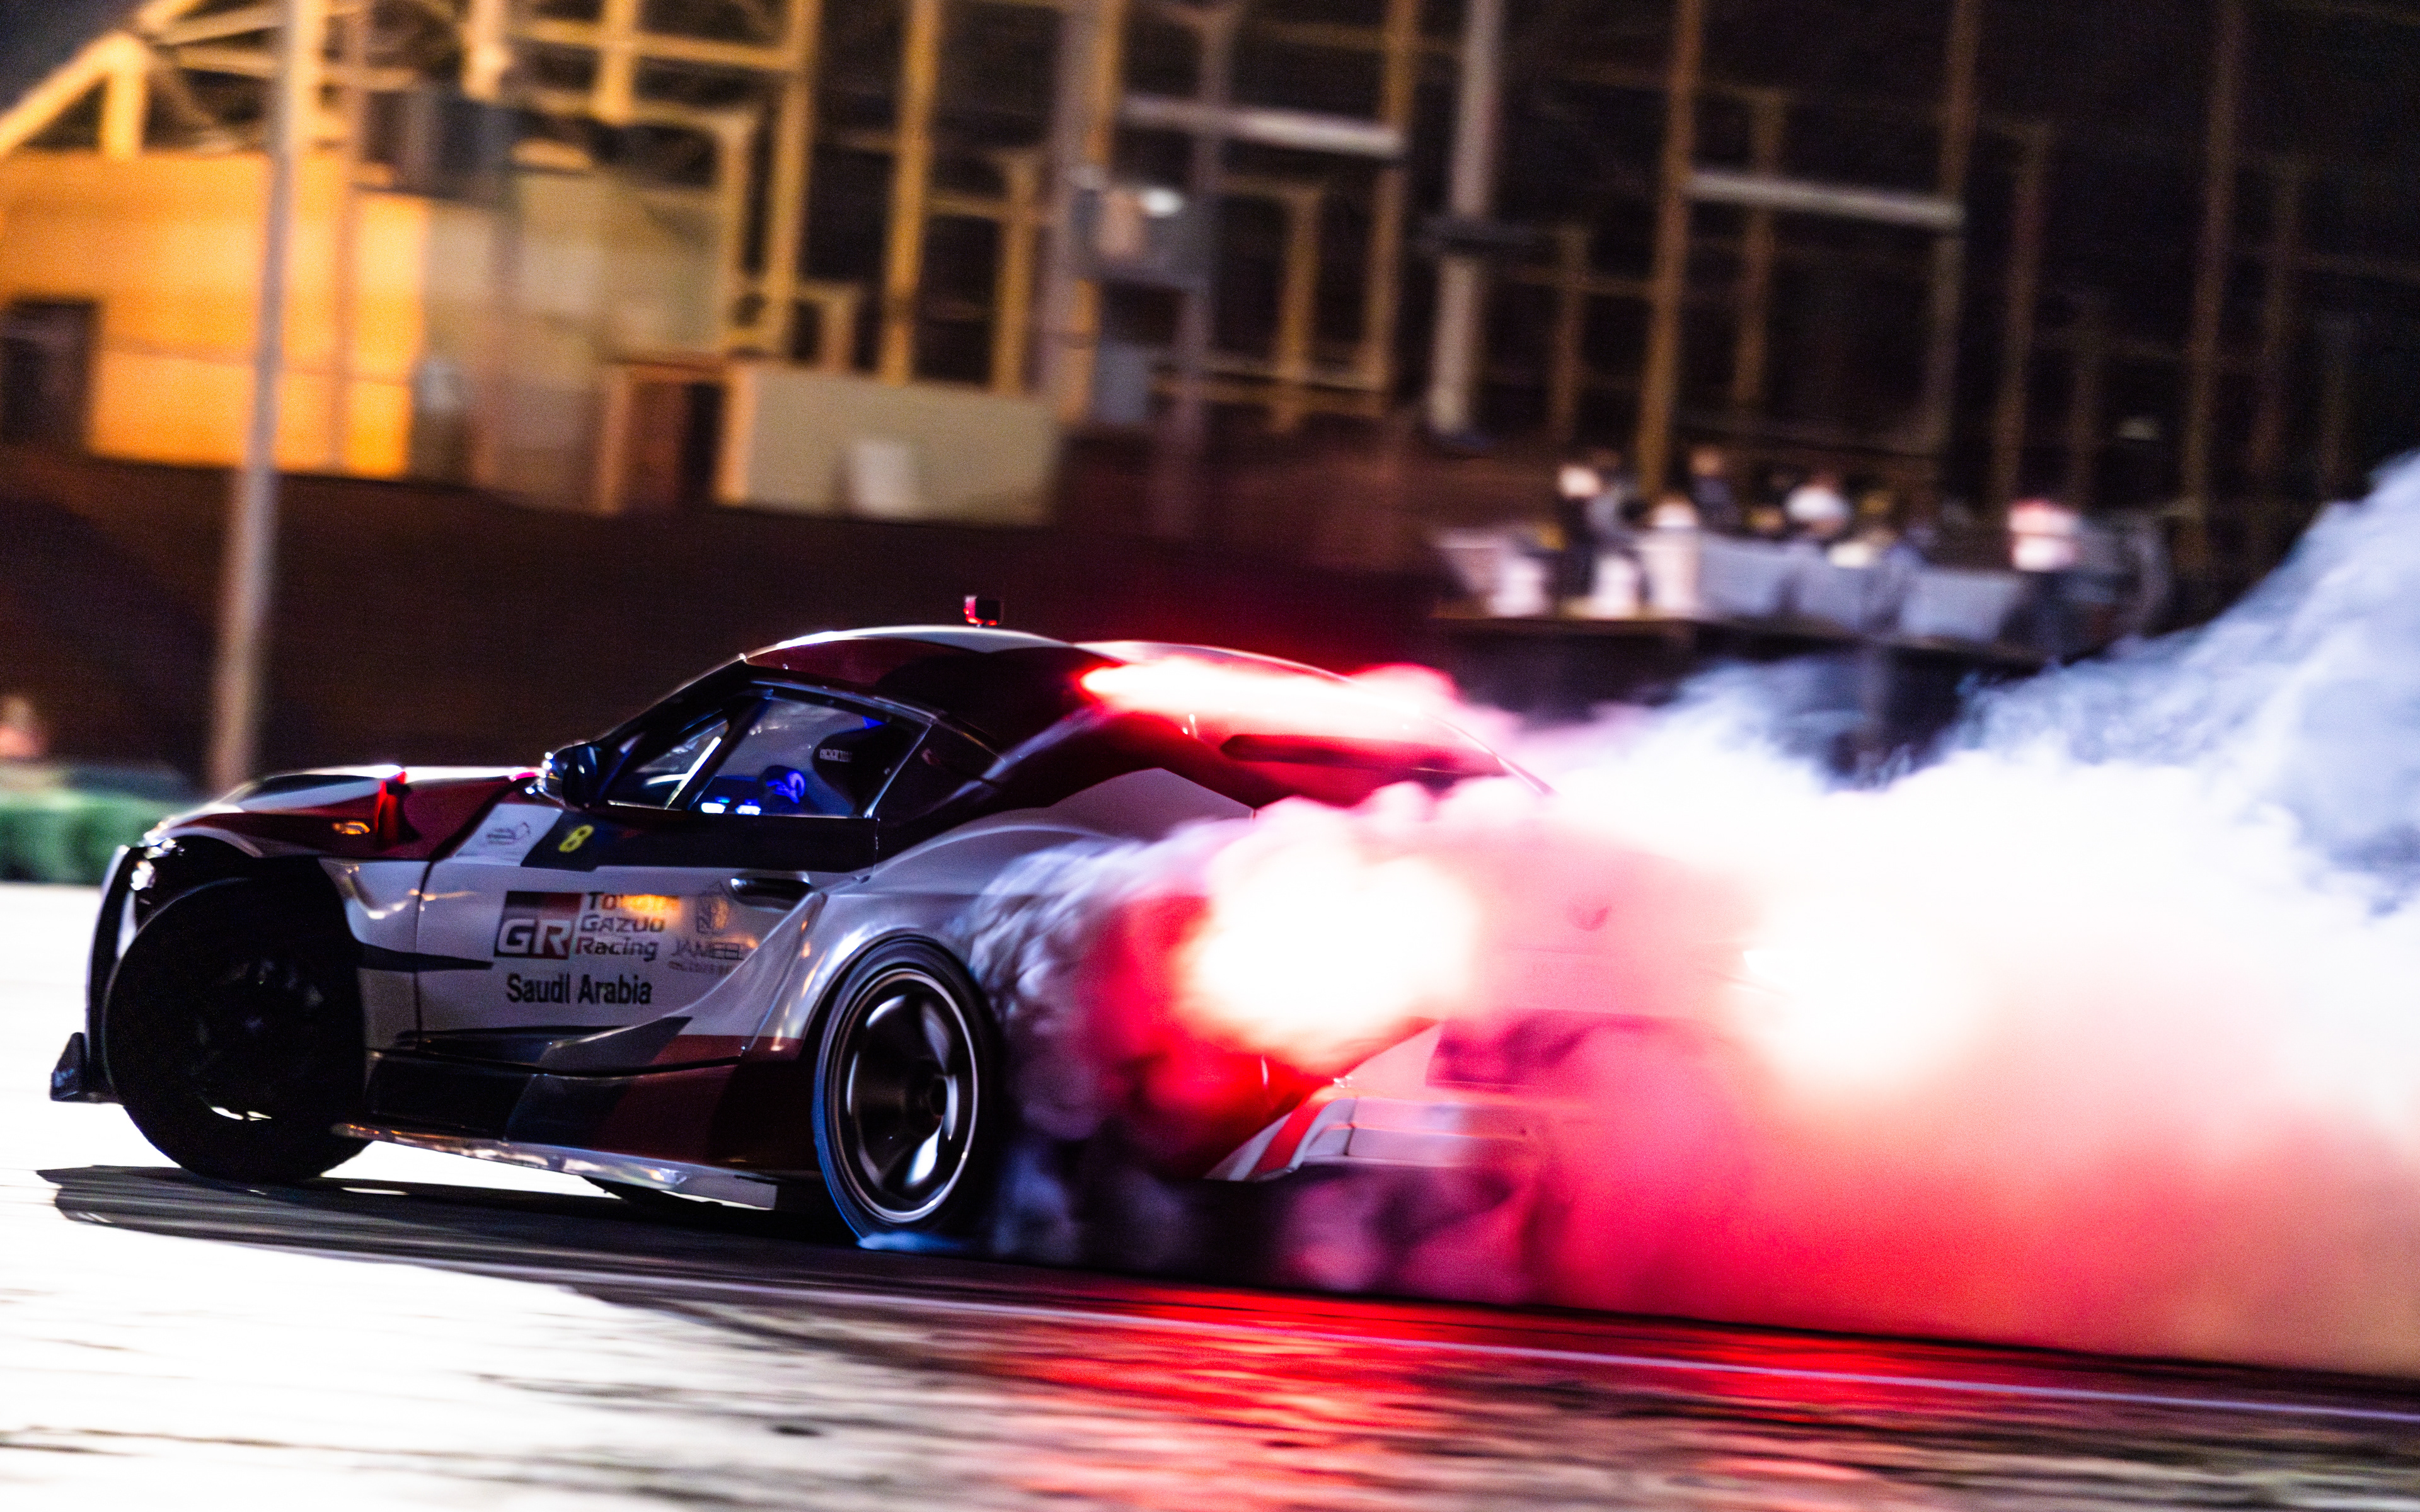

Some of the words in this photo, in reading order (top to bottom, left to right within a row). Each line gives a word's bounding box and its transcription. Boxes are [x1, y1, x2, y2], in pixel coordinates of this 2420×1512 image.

[497, 918, 570, 955] GR
[575, 936, 659, 962] Racing
[506, 973, 570, 1004] Saudi
[578, 974, 652, 1004] Arabia
